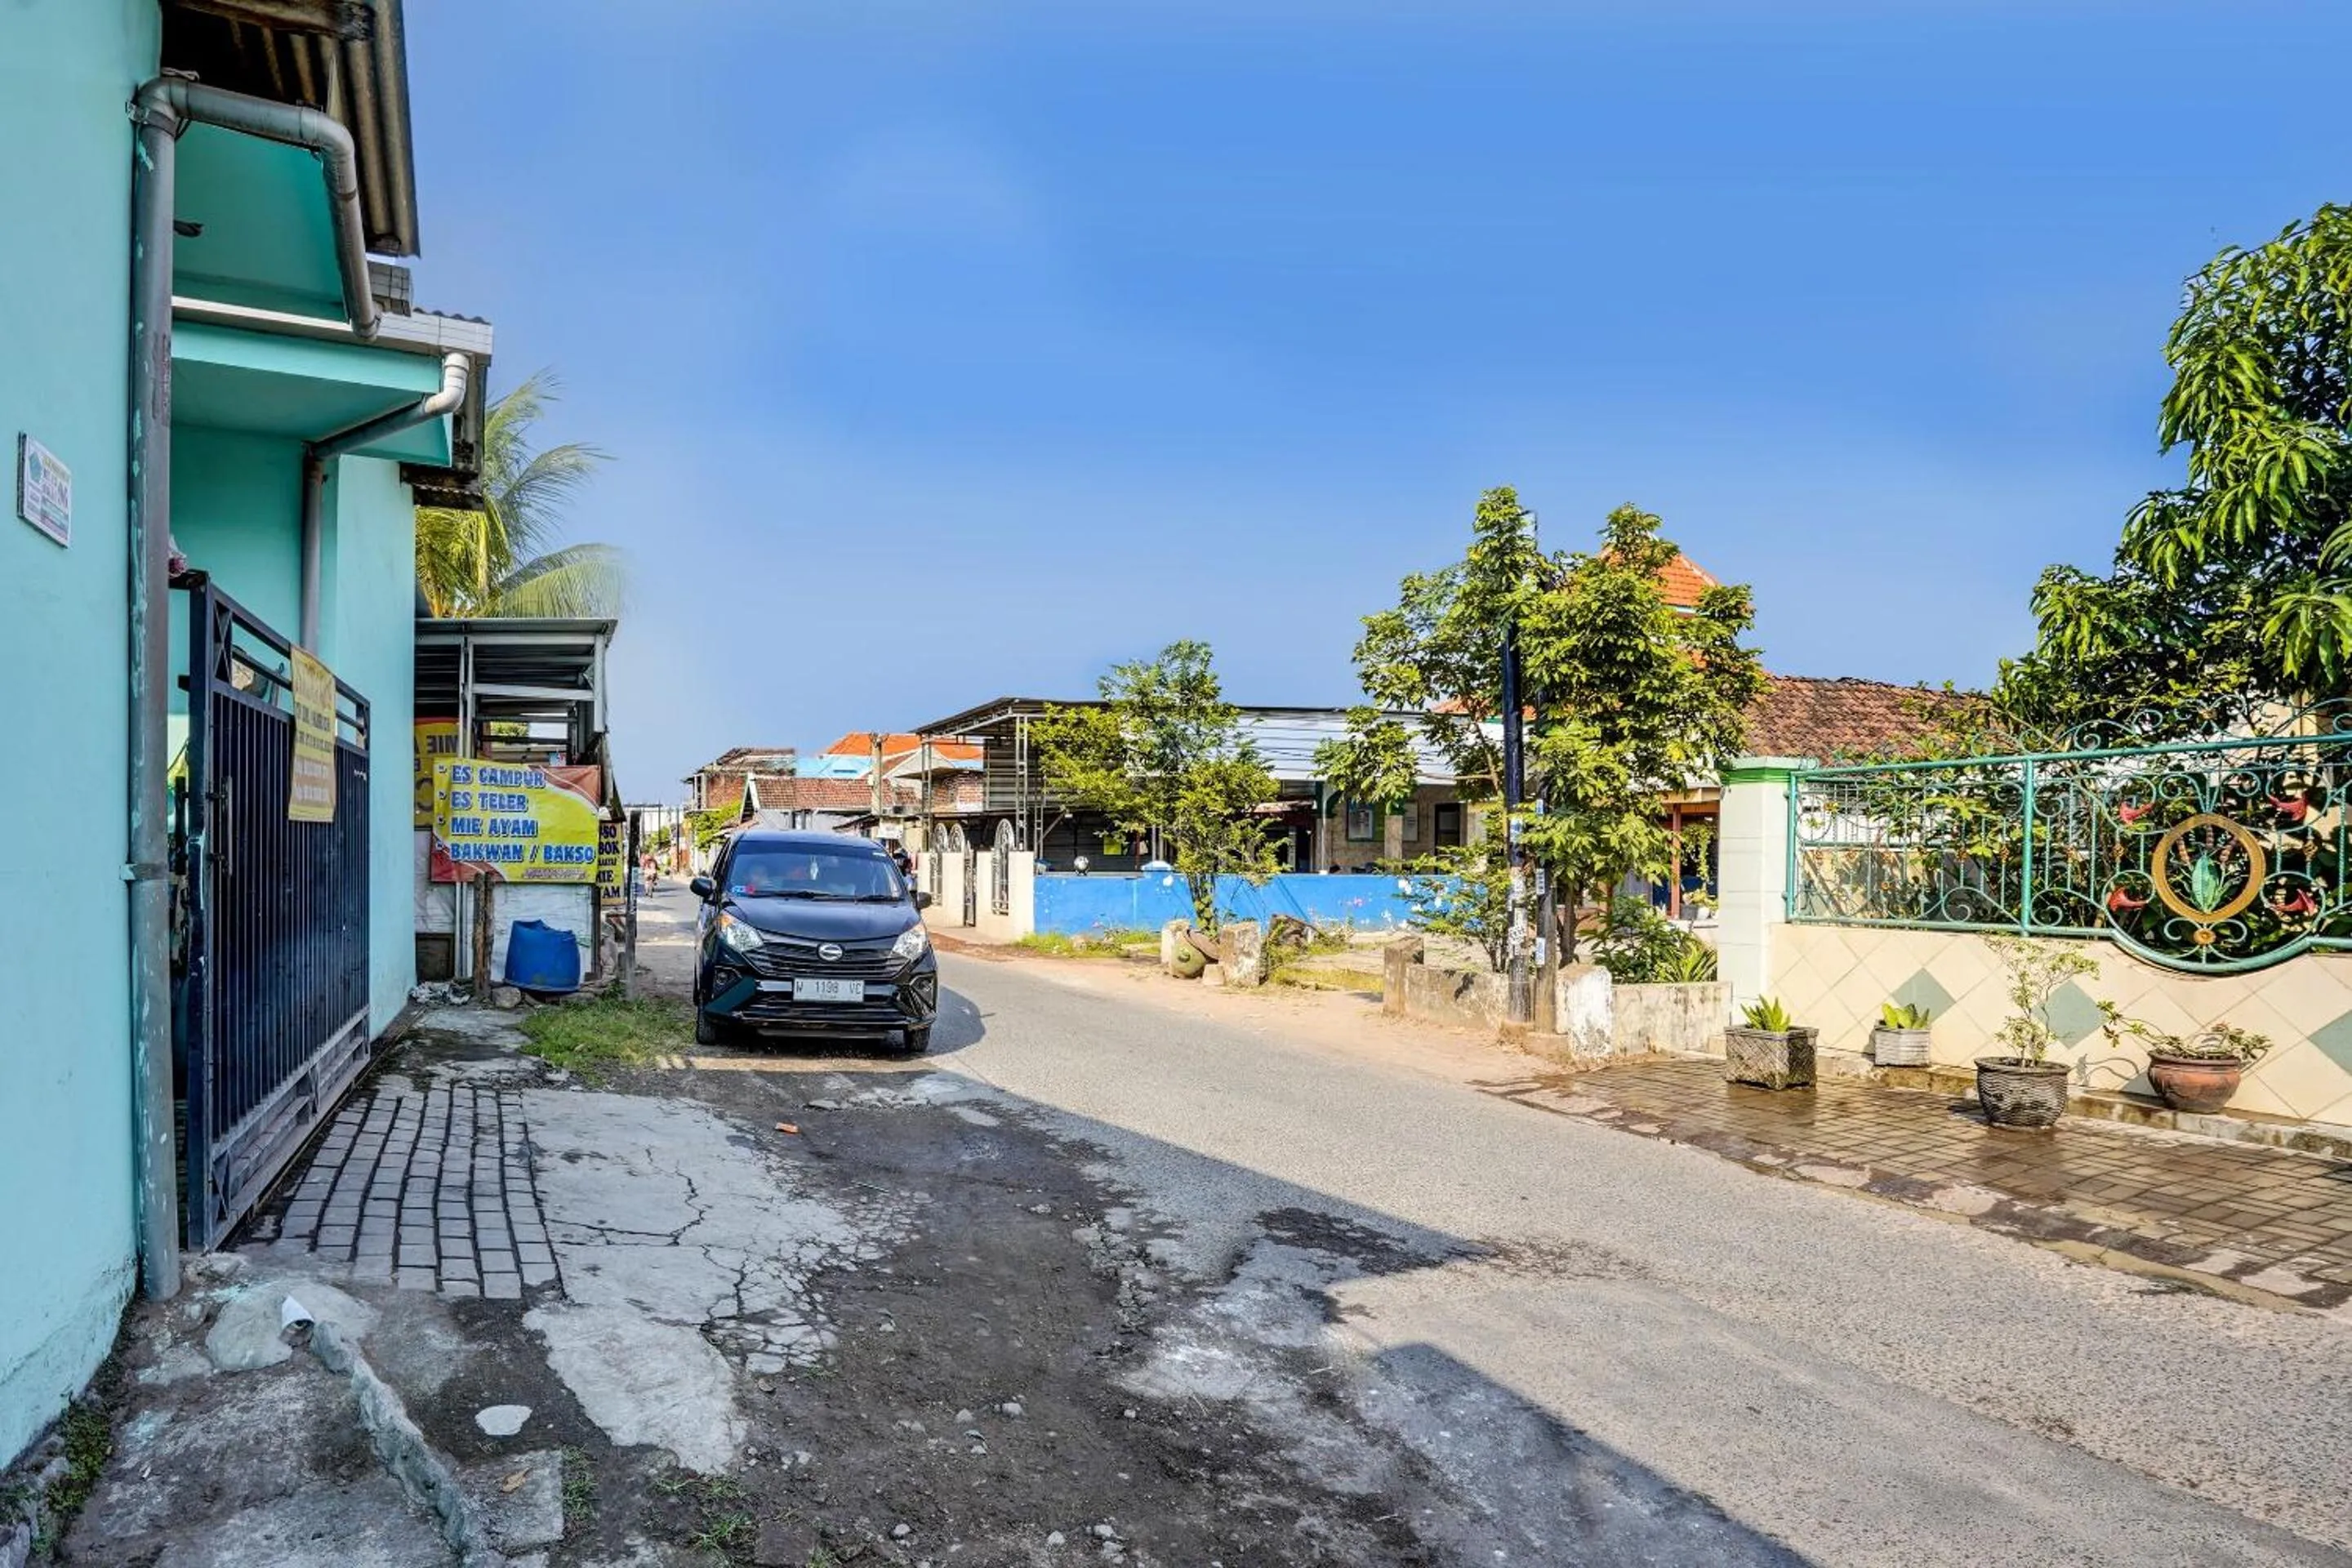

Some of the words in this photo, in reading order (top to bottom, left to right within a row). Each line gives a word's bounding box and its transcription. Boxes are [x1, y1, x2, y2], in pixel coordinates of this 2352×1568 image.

[452, 764, 473, 784] ES
[479, 767, 546, 789] CAMPUR
[451, 791, 472, 810] ES
[478, 792, 529, 812] TELER
[451, 817, 483, 835] MIE
[488, 817, 539, 837] AYAM
[450, 843, 524, 862] BAKWAN
[542, 844, 596, 864] BAKSO
